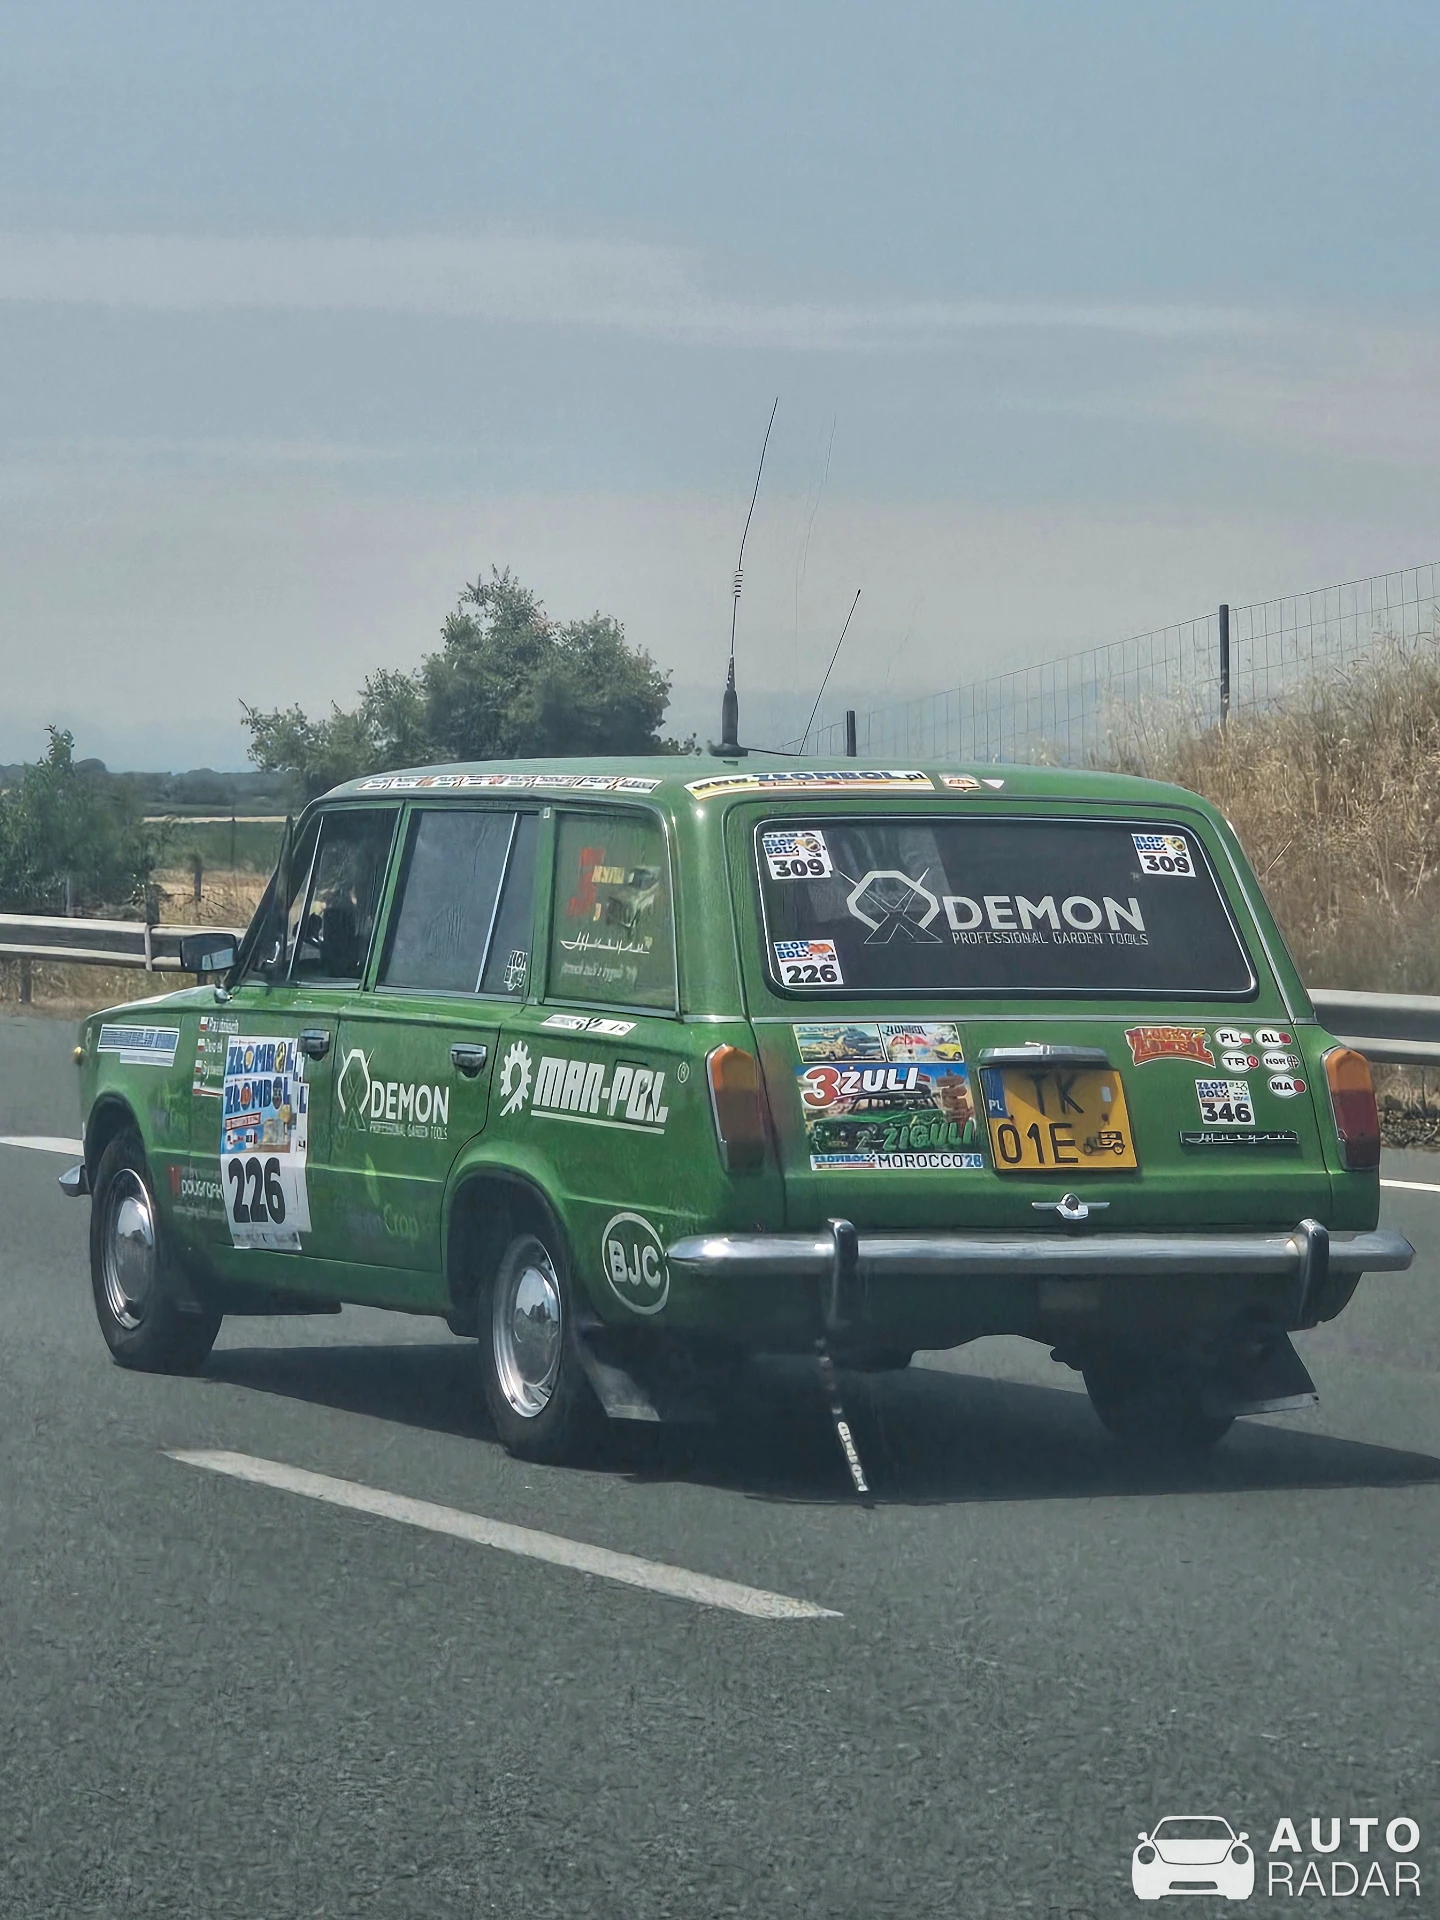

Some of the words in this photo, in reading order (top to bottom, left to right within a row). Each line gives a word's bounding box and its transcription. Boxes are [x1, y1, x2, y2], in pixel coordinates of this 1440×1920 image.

[773, 859, 825, 877] 309
[1143, 855, 1190, 873] 309
[942, 896, 1146, 931] DEMON
[953, 932, 1049, 945] PROFESSIONAL
[1053, 932, 1102, 944] GARDEN
[1108, 932, 1149, 945] TOOLS
[786, 965, 837, 983] 226
[1220, 1034, 1239, 1042] PL
[1262, 1034, 1279, 1043] AL
[1271, 1082, 1293, 1090] MA
[370, 1081, 449, 1124] DEMON
[988, 1100, 1003, 1111] PL
[1202, 1103, 1252, 1122] 346
[997, 1123, 1079, 1164] 01E
[878, 1154, 963, 1168] MOROCCO
[229, 1157, 286, 1225] 226
